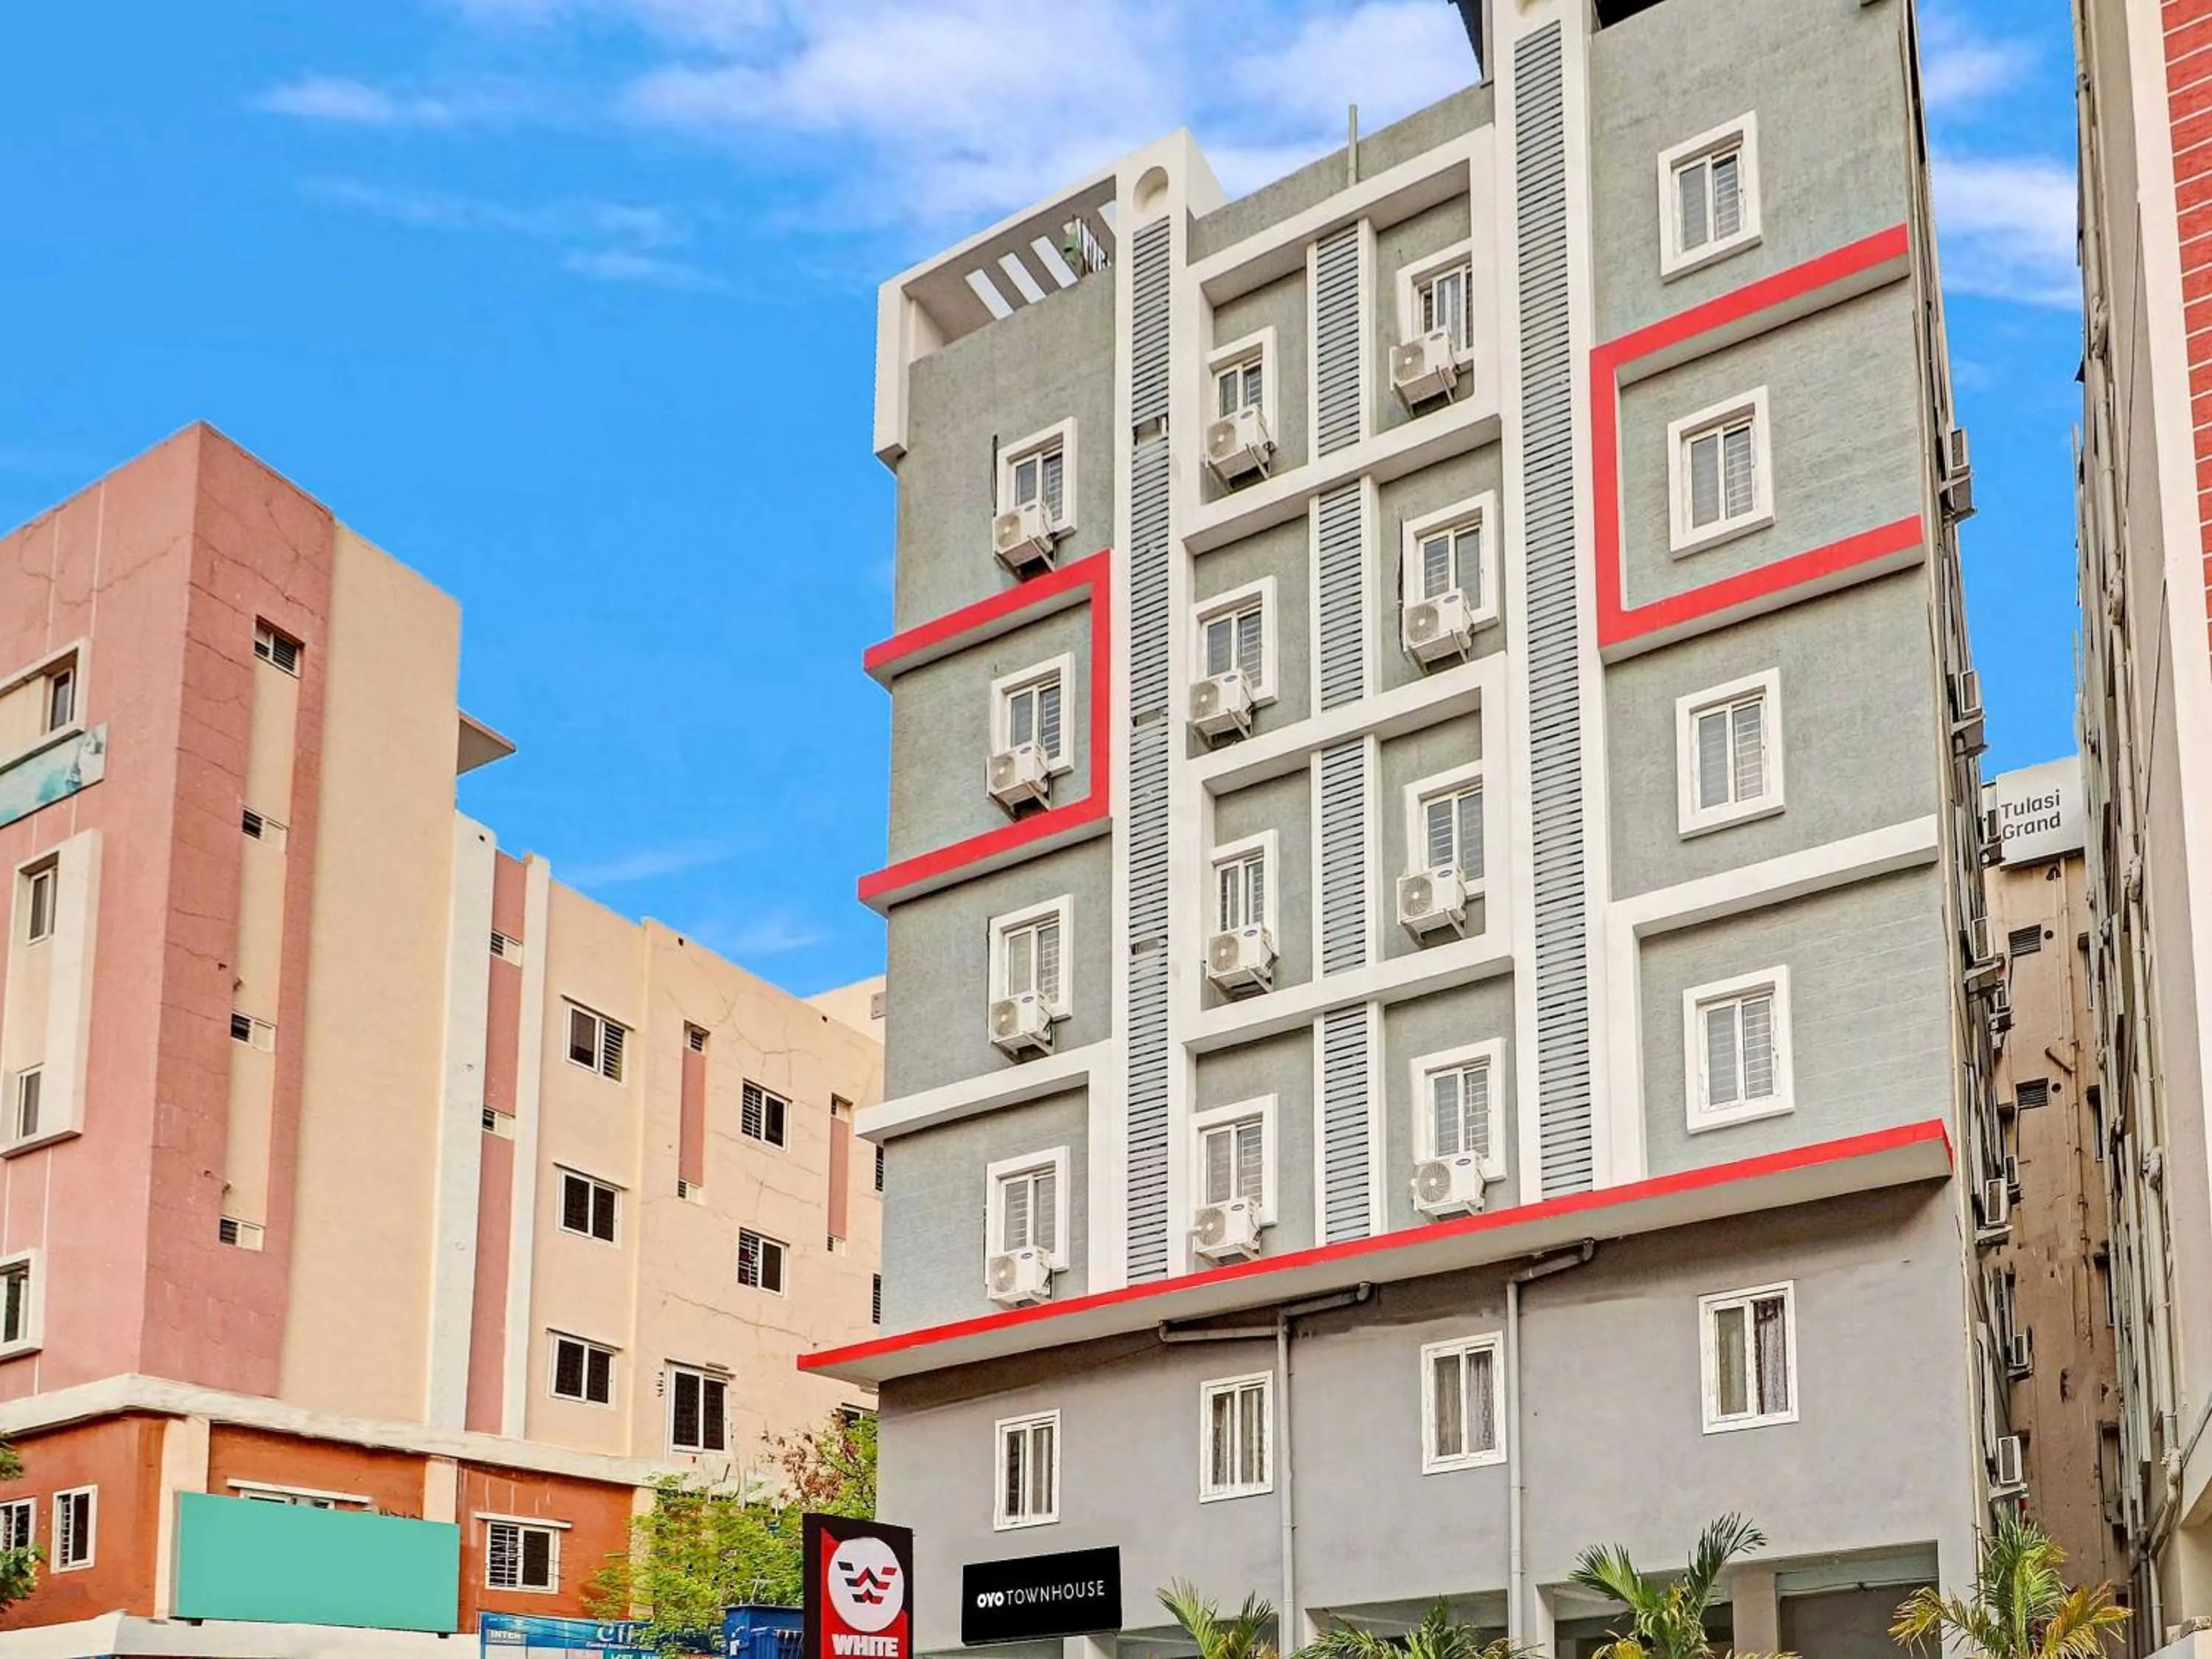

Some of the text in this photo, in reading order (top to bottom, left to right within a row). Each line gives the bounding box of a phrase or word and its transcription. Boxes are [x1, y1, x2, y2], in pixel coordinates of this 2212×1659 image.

[2000, 788, 2060, 818] Tulasi
[2002, 811, 2061, 839] Grand
[977, 1580, 1105, 1608] OYO TOWNHOUSE
[831, 1634, 899, 1658] WHITE
